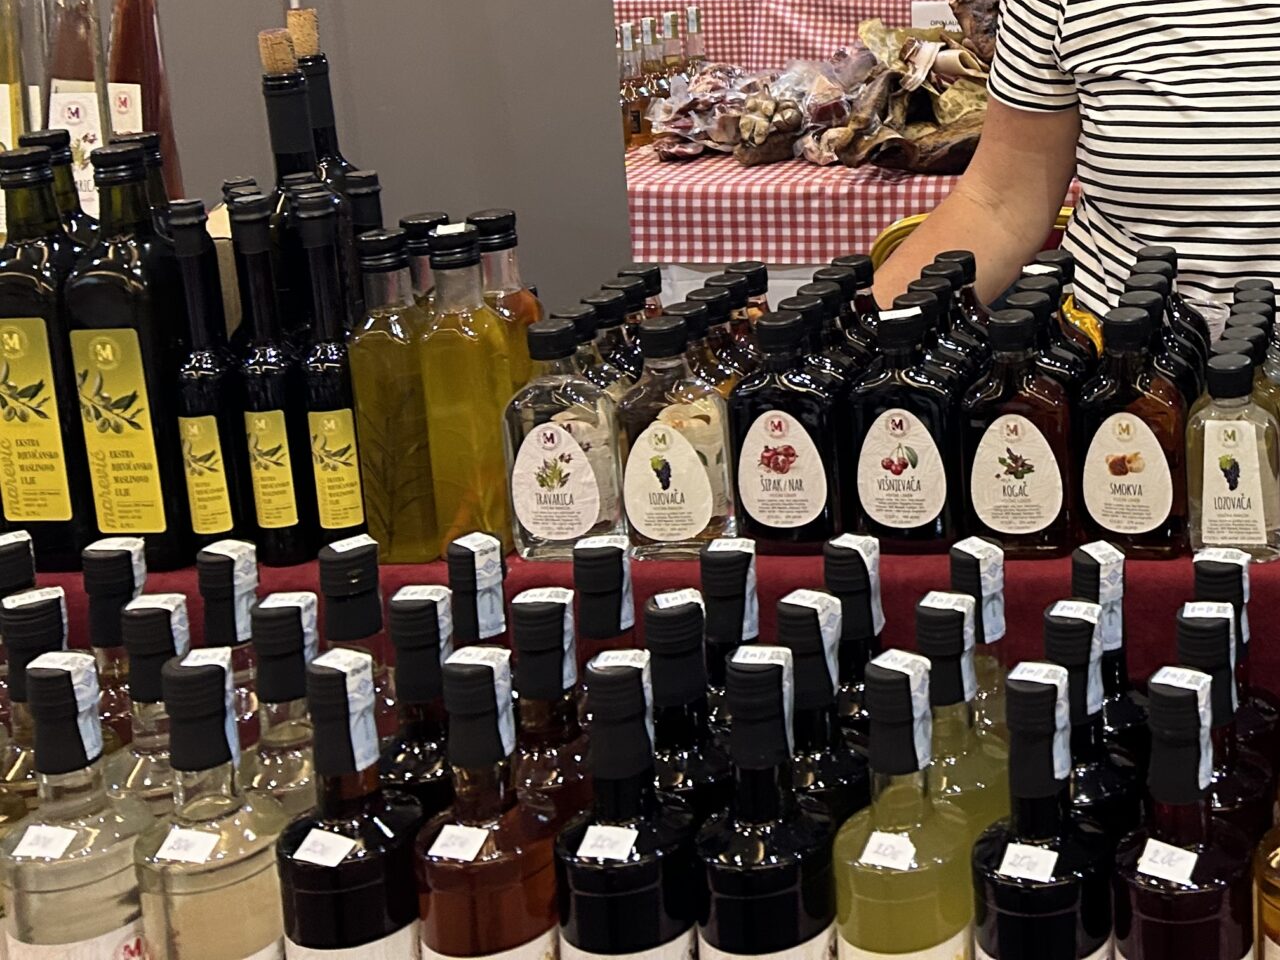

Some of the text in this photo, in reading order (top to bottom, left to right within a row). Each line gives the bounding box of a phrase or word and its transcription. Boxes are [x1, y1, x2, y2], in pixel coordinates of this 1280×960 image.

[877, 476, 921, 492] VIŠNJEVAČA
[1110, 483, 1143, 496] SMOKVA
[535, 493, 575, 506] TRAVARICA
[1214, 493, 1252, 510] LOZOVAČA
